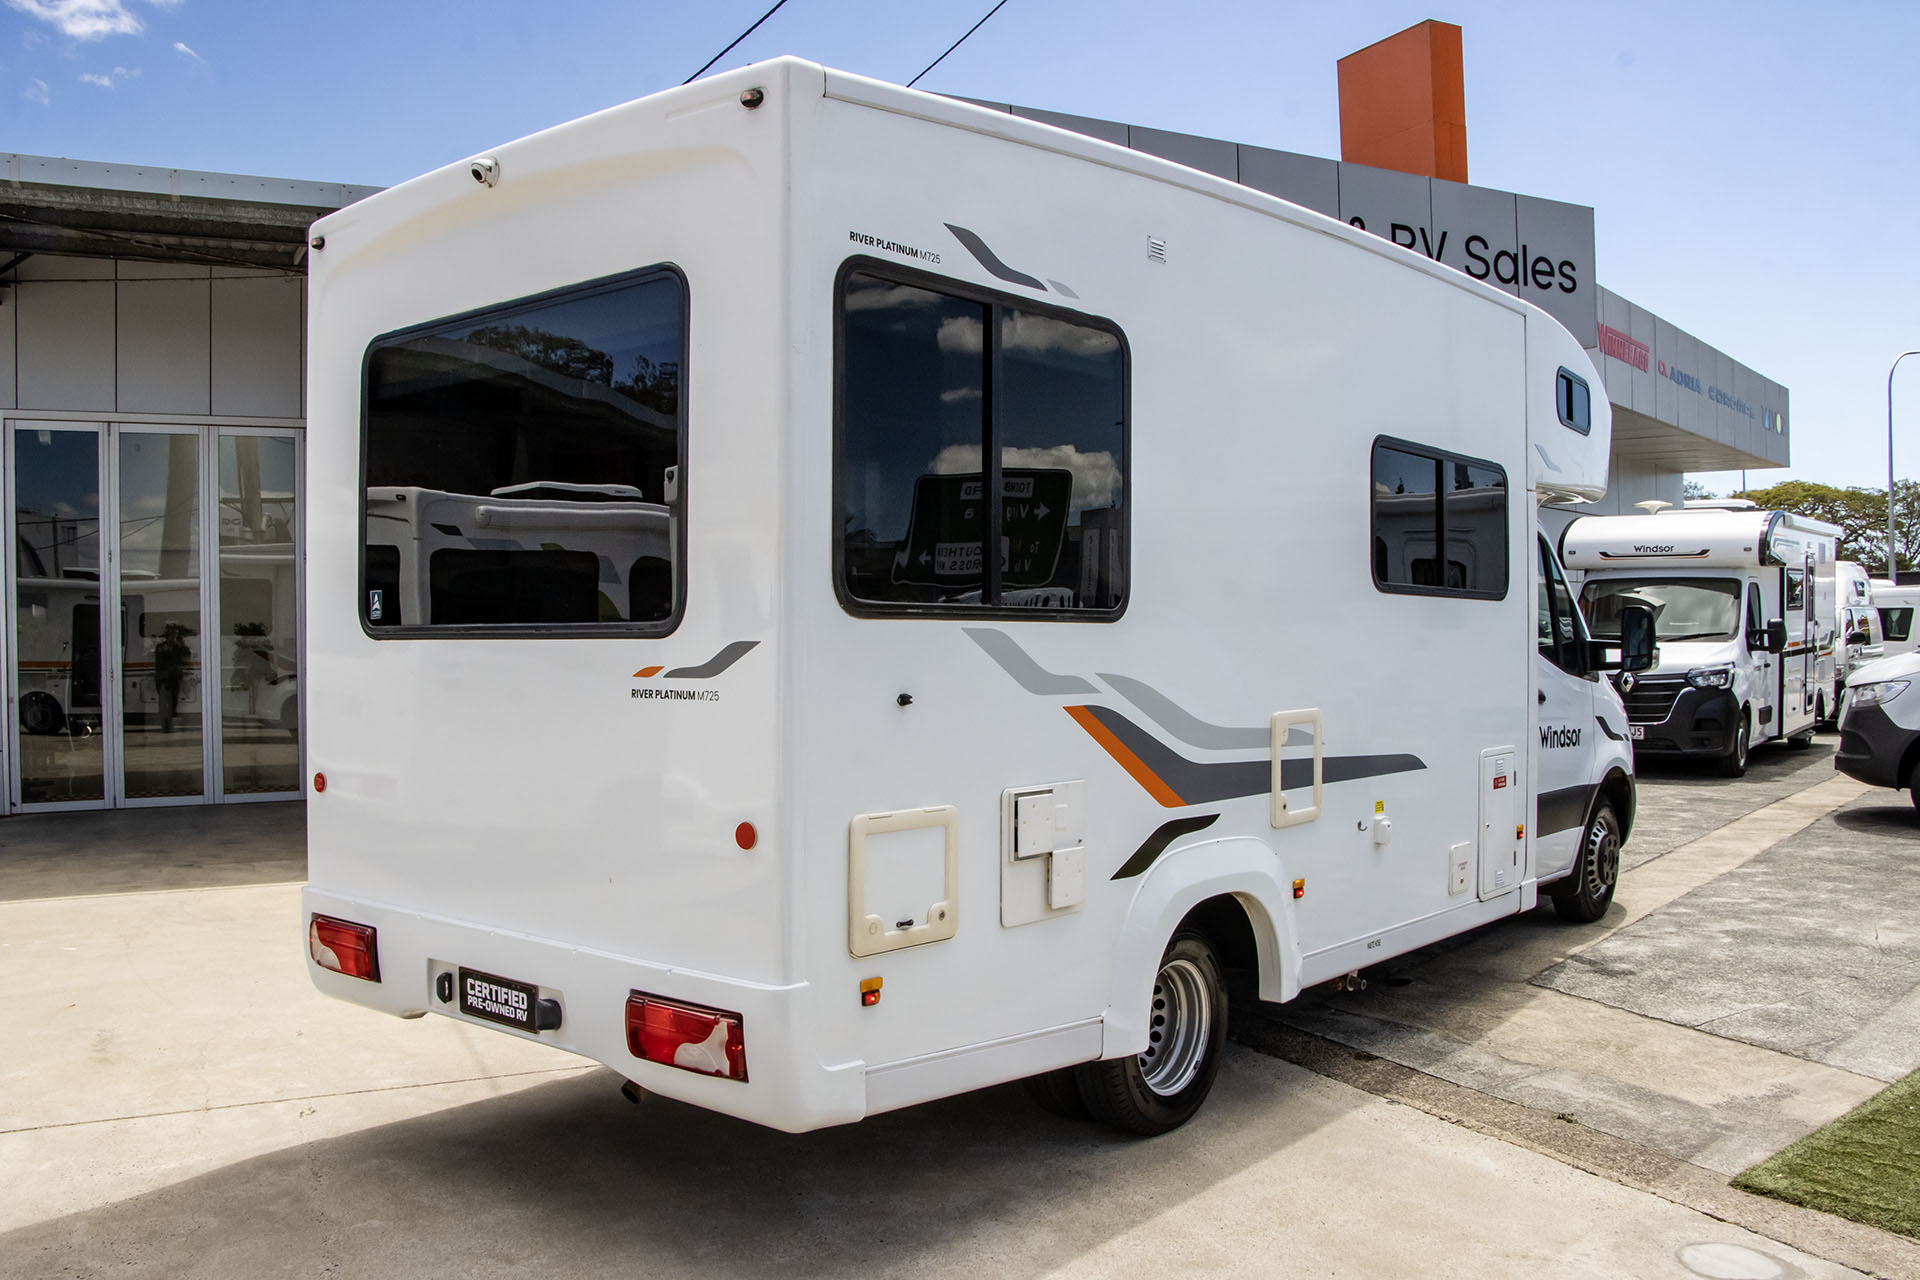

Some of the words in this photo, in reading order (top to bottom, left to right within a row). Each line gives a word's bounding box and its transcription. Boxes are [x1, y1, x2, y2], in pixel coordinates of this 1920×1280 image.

[849, 231, 875, 247] RIVER
[876, 238, 918, 258] PLATINUM
[919, 250, 941, 264] M725
[1464, 235, 1577, 293] Sales
[1668, 366, 1703, 396] ADRIA
[1633, 544, 1675, 553] Windsor
[631, 688, 654, 699] RIVER
[655, 689, 696, 701] PLATINUM
[697, 691, 720, 702] M725
[1539, 725, 1582, 749] Windsor
[466, 978, 528, 1010] CERTIFIED
[467, 995, 515, 1019] PRE-OWNED
[516, 1008, 528, 1022] RV
